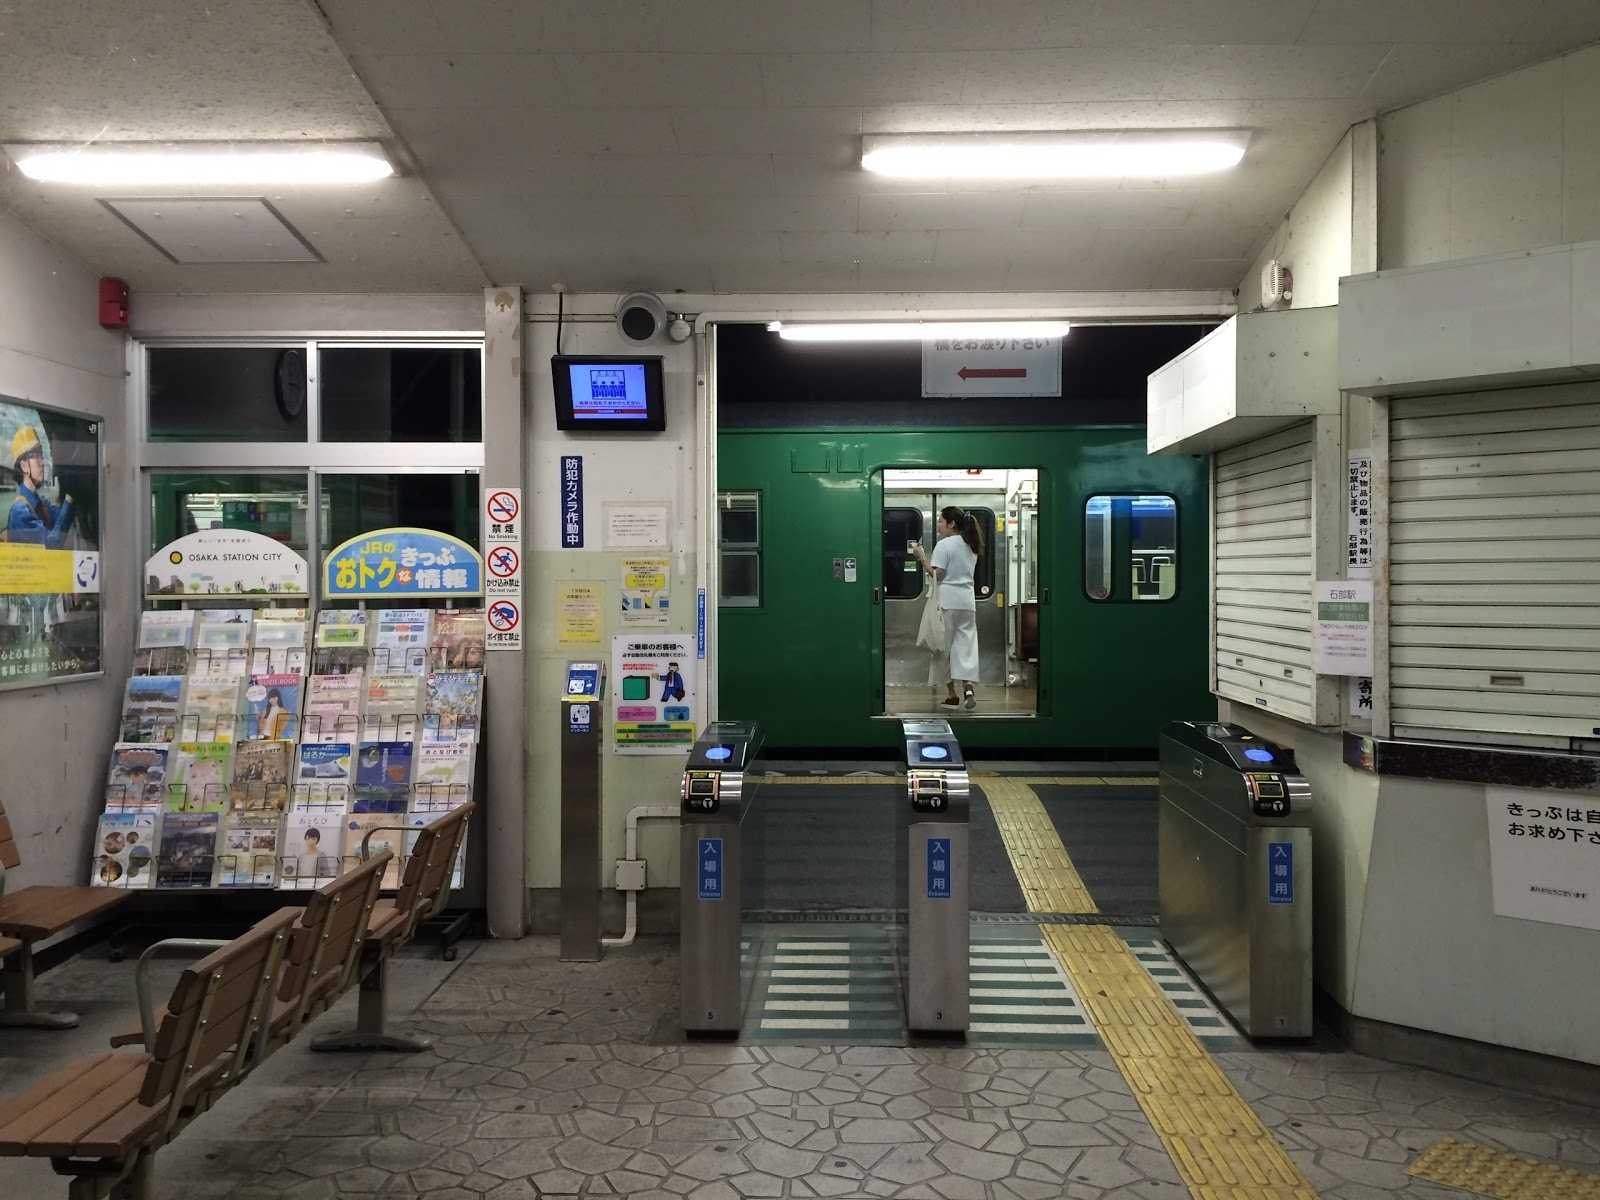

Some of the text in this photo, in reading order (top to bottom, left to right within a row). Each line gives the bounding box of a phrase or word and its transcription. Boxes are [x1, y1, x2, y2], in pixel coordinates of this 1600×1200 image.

[1349, 461, 1359, 517] 一切禁止します。
[565, 458, 579, 545] 防犯カメラ作動中
[492, 523, 514, 534] 禁煙
[189, 553, 282, 562] OSAKA STATION CITY
[360, 542, 395, 554] JRの
[400, 546, 456, 566] きっぷ
[336, 557, 468, 590] おトク な 情報
[487, 578, 520, 587] かけ込み禁止
[1330, 589, 1357, 600] 石部駅
[487, 633, 520, 642] ポイ捨て禁止
[1507, 803, 1600, 824] きっぷは自
[1507, 822, 1600, 844] お求め下さ
[704, 842, 717, 890] 入場用
[932, 841, 946, 889] 入場用
[1274, 846, 1288, 895] 入場用
